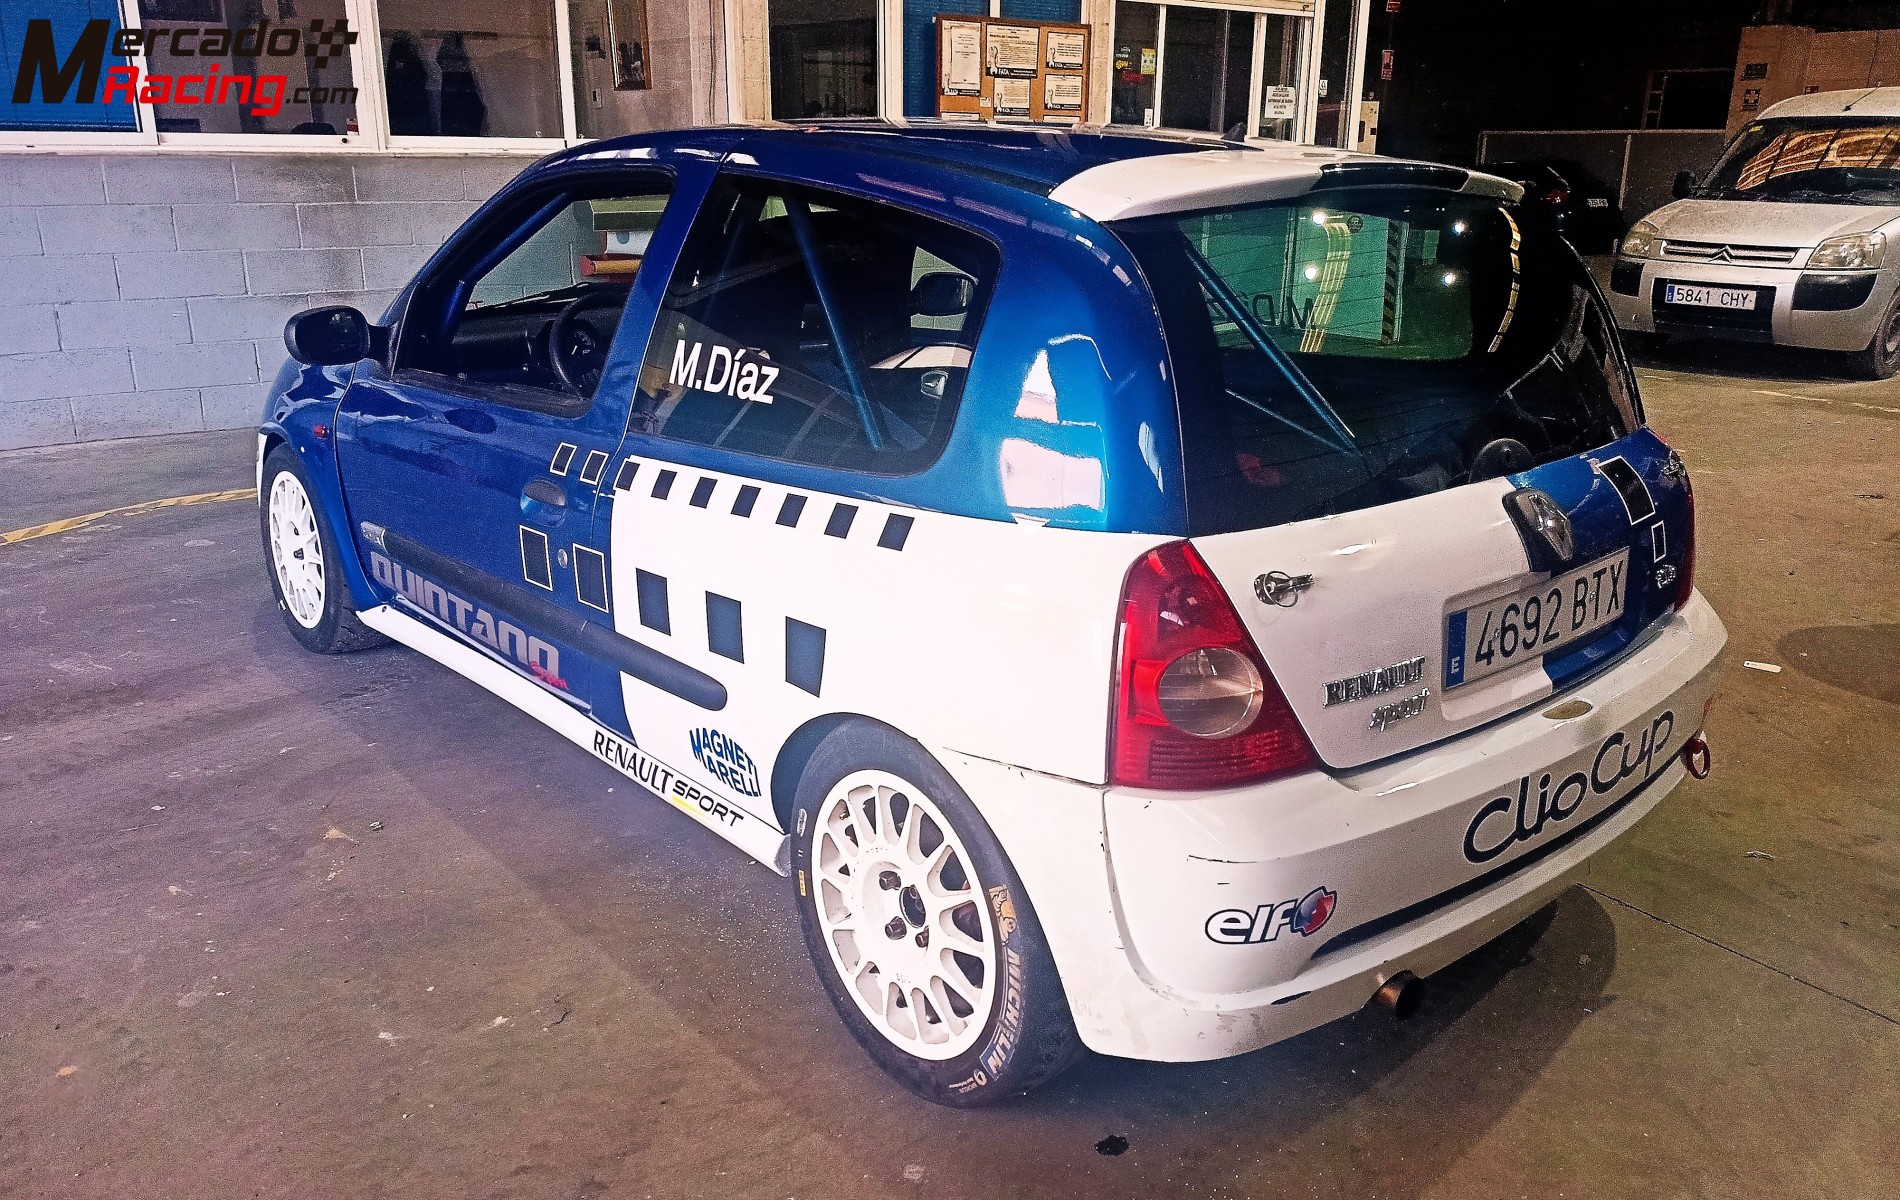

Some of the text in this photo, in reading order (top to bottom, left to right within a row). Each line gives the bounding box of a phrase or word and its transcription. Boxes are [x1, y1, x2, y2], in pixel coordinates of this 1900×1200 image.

[1676, 288, 1749, 307] 5841 CHY
[668, 339, 780, 405] M.Díaz
[1475, 560, 1624, 666] 4692 BTX
[1322, 656, 1426, 709] RENAULT
[1451, 656, 1460, 674] E
[594, 730, 674, 794] RENAULT
[672, 779, 744, 827] SPORT
[1204, 899, 1302, 945] elf
